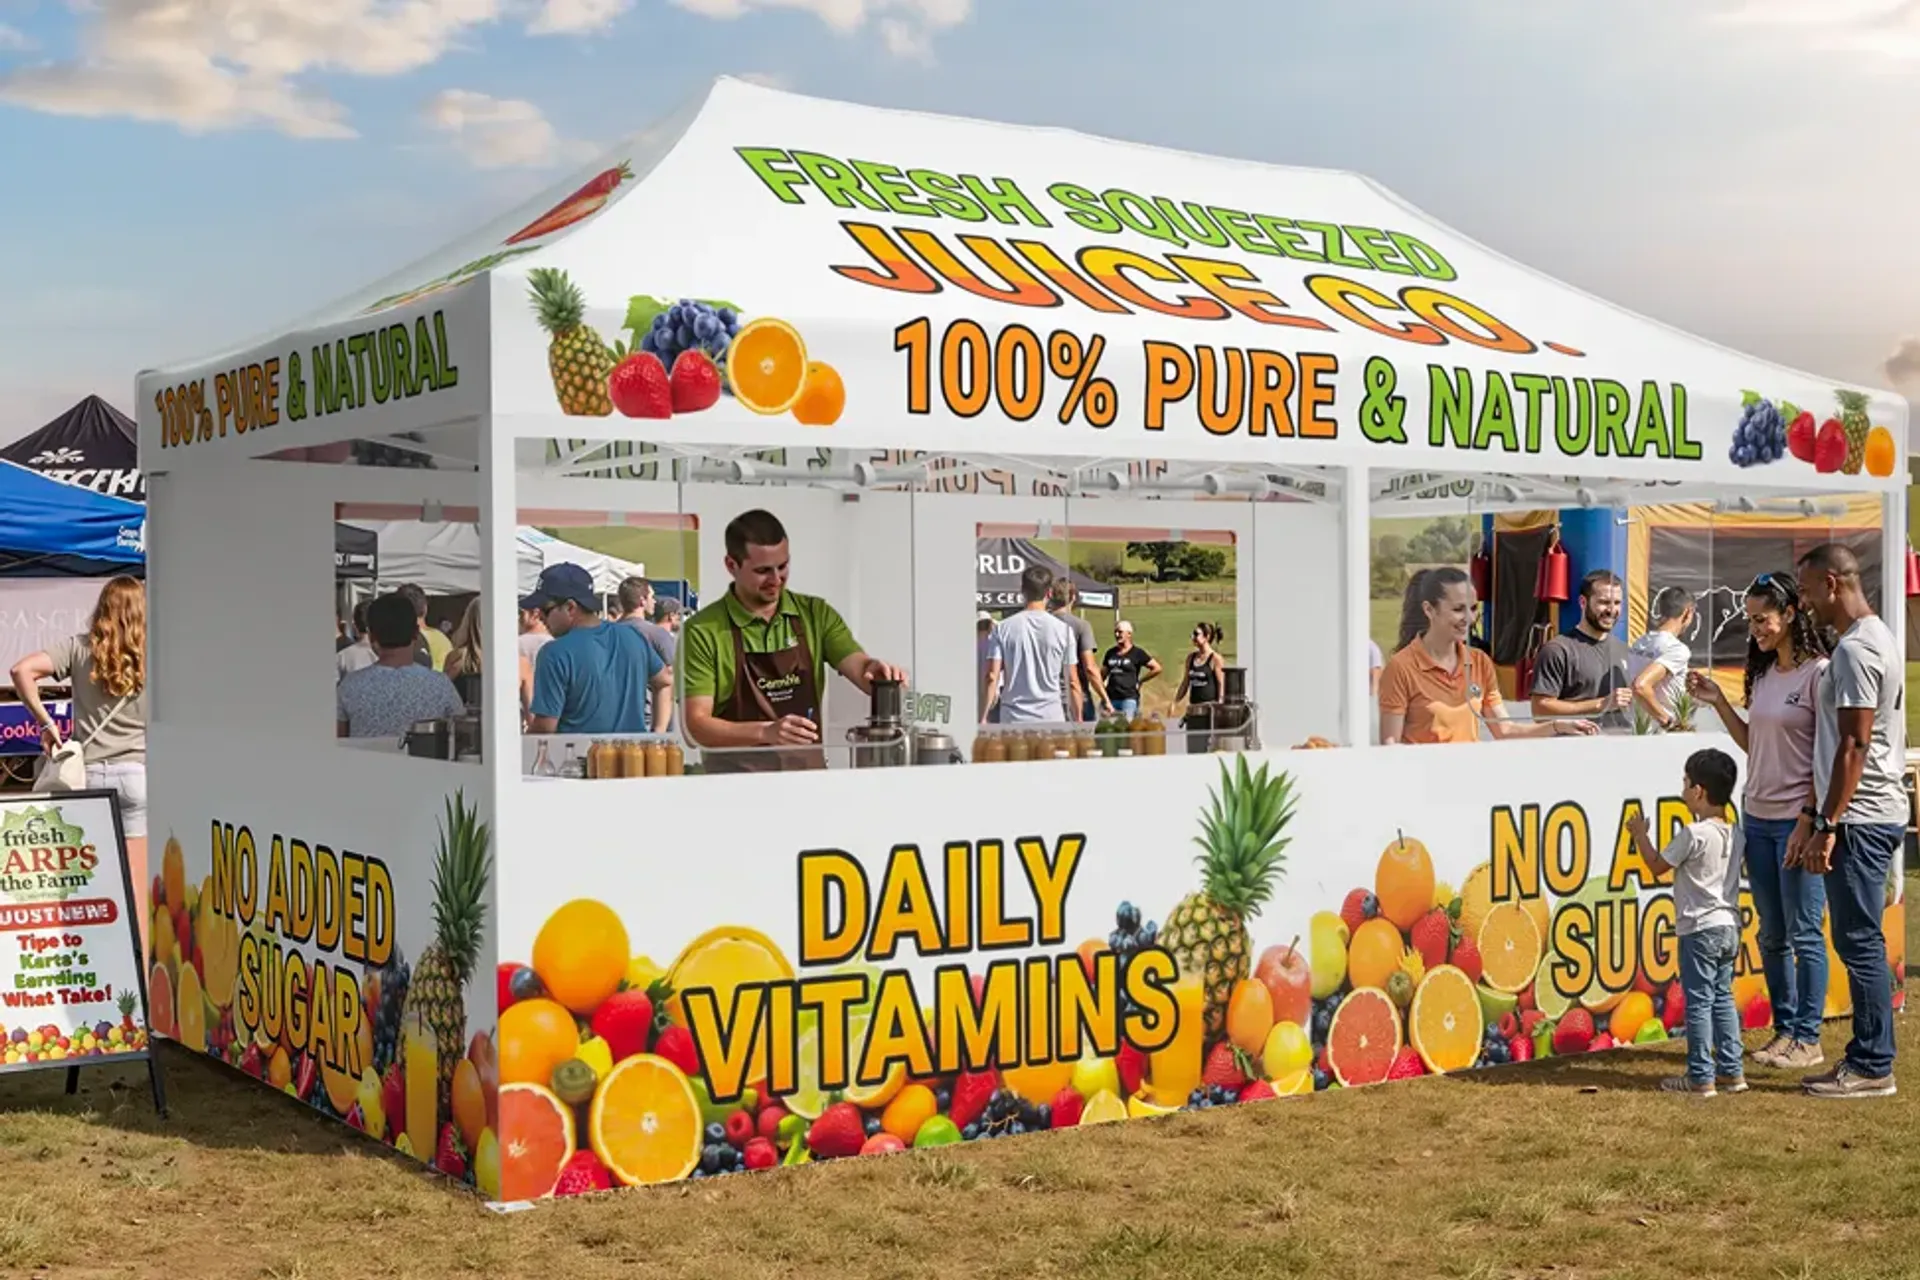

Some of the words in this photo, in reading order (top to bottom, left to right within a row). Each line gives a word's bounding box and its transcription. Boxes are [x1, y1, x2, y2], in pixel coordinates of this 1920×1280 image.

[733, 146, 1051, 230] FRESH
[1045, 180, 1457, 282] SQUEEZED
[829, 220, 1339, 332] JUICE
[1303, 273, 1586, 357] CO.
[155, 377, 214, 449] 100%
[215, 356, 280, 437] PURE
[286, 350, 307, 422] &
[312, 309, 459, 417] NATURAL
[893, 316, 1117, 429] 100%
[1142, 340, 1339, 440] PURE
[1359, 355, 1408, 445] &
[1426, 364, 1703, 461] NATURAL
[975, 553, 1025, 574] RLD
[0, 875, 33, 892] the
[36, 873, 88, 889] Farm
[211, 819, 258, 927] NO
[265, 833, 395, 968] ADDED
[797, 832, 1087, 967] DAILY
[1490, 800, 1591, 903] NO
[2, 991, 55, 1008] What
[238, 931, 363, 1081] SUGAR
[1551, 887, 1765, 999] SUGR
[682, 944, 1181, 1103] VITAMINS
